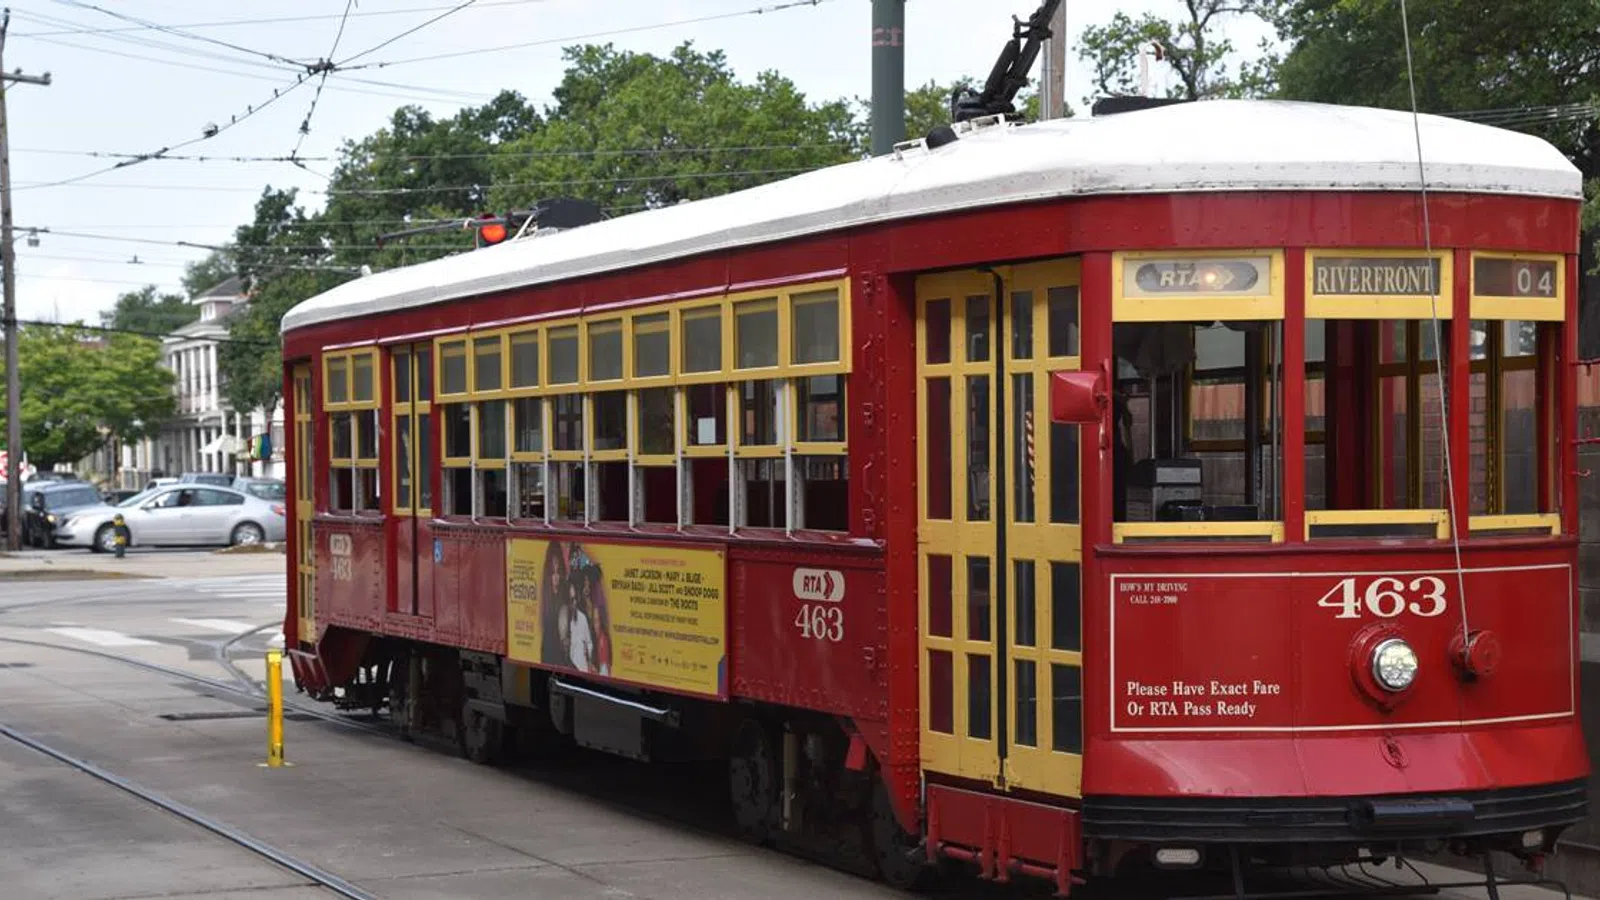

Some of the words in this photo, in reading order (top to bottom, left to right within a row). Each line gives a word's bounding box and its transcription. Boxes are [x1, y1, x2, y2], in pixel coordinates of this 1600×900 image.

[1160, 269, 1203, 287] RTA
[1316, 265, 1434, 293] RIVERFRONT
[803, 575, 821, 593] RTA
[1143, 583, 1155, 592] MY
[1157, 582, 1188, 592] DRIVING
[680, 599, 698, 610] ROOTS
[1130, 594, 1149, 604] CALL
[1317, 576, 1447, 619] 463
[794, 604, 844, 642] 463
[1127, 681, 1167, 696] Please
[1172, 681, 1205, 695] Have
[1210, 681, 1248, 695] Exact
[1253, 680, 1280, 695] Fare
[1127, 701, 1144, 716] Or
[1150, 701, 1179, 716] RTA
[1184, 701, 1212, 716] Pass
[1217, 701, 1257, 718] Ready
